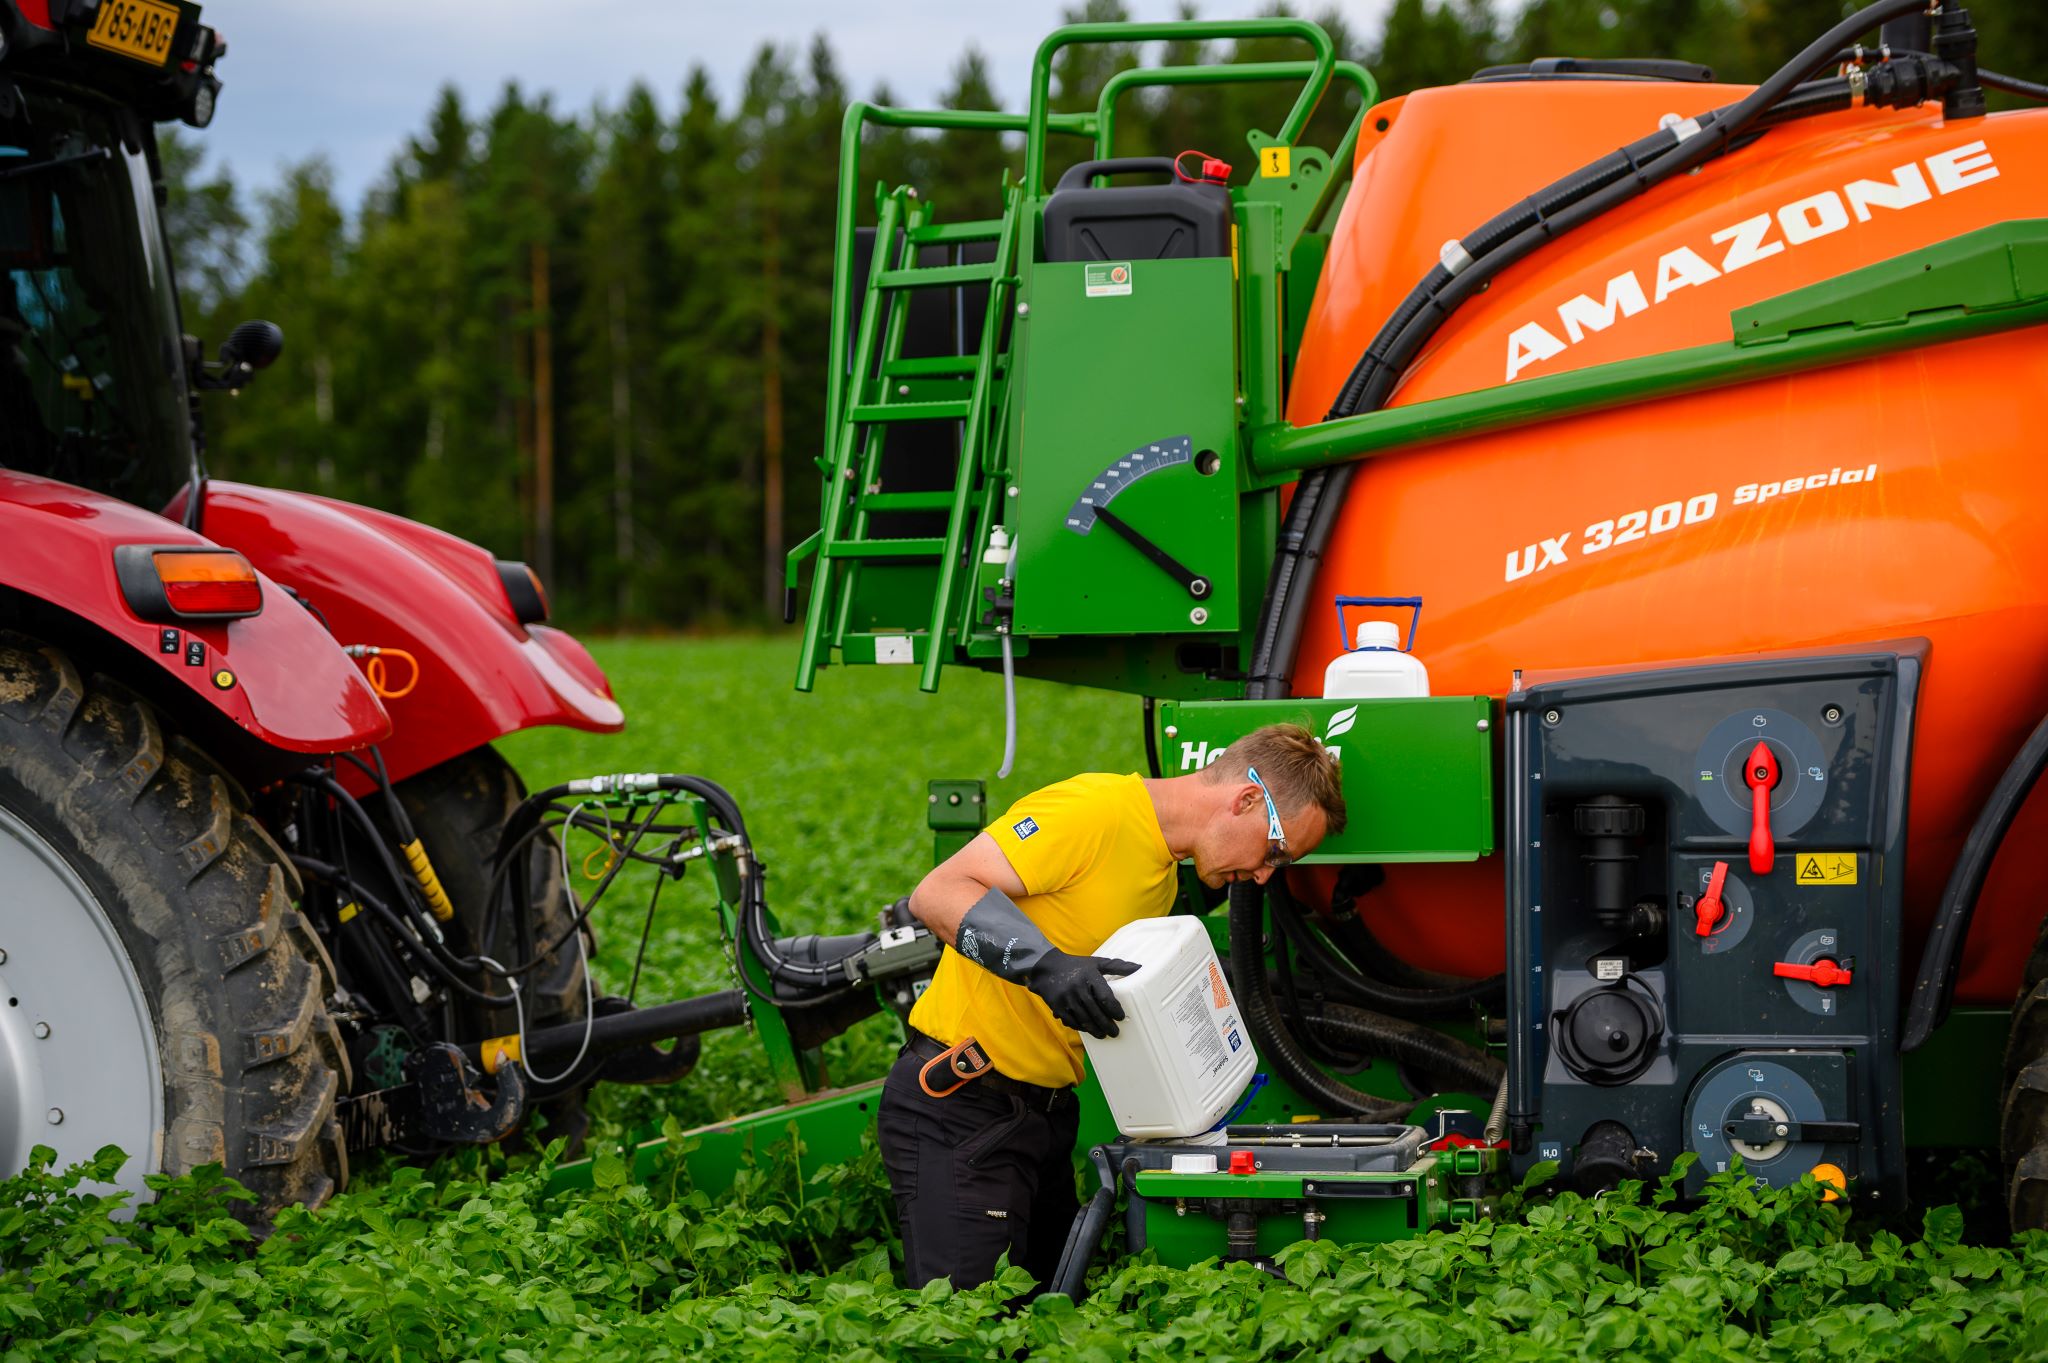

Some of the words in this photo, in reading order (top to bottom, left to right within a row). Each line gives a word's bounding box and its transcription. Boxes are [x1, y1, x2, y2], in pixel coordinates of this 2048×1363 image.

[1505, 139, 2000, 383] AMAZONE
[1505, 532, 1572, 582] UX
[1582, 492, 1718, 554] 3200
[1733, 464, 1877, 505] Special
